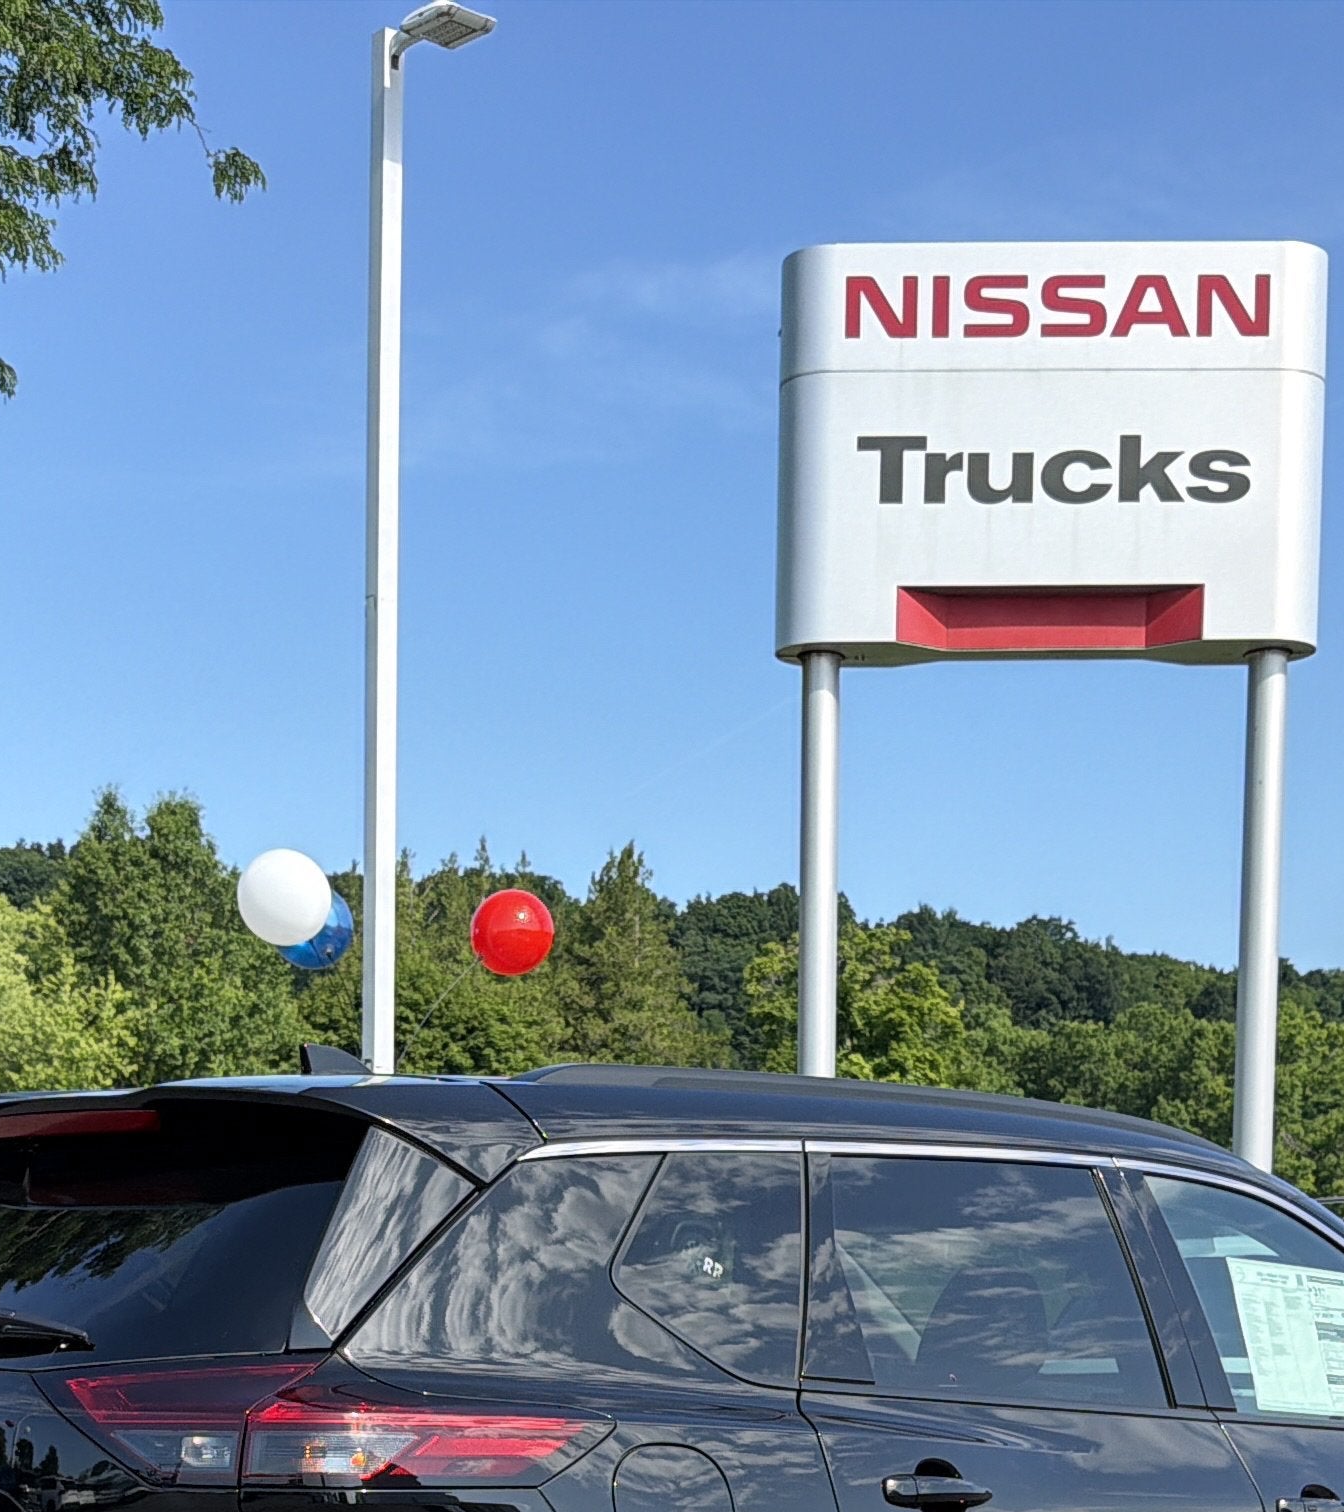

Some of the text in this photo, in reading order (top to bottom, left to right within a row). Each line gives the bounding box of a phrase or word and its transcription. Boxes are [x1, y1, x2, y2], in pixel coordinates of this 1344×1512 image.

[844, 273, 1271, 339] NISSAN
[856, 434, 1252, 504] Trucks
[703, 1256, 724, 1278] RR
